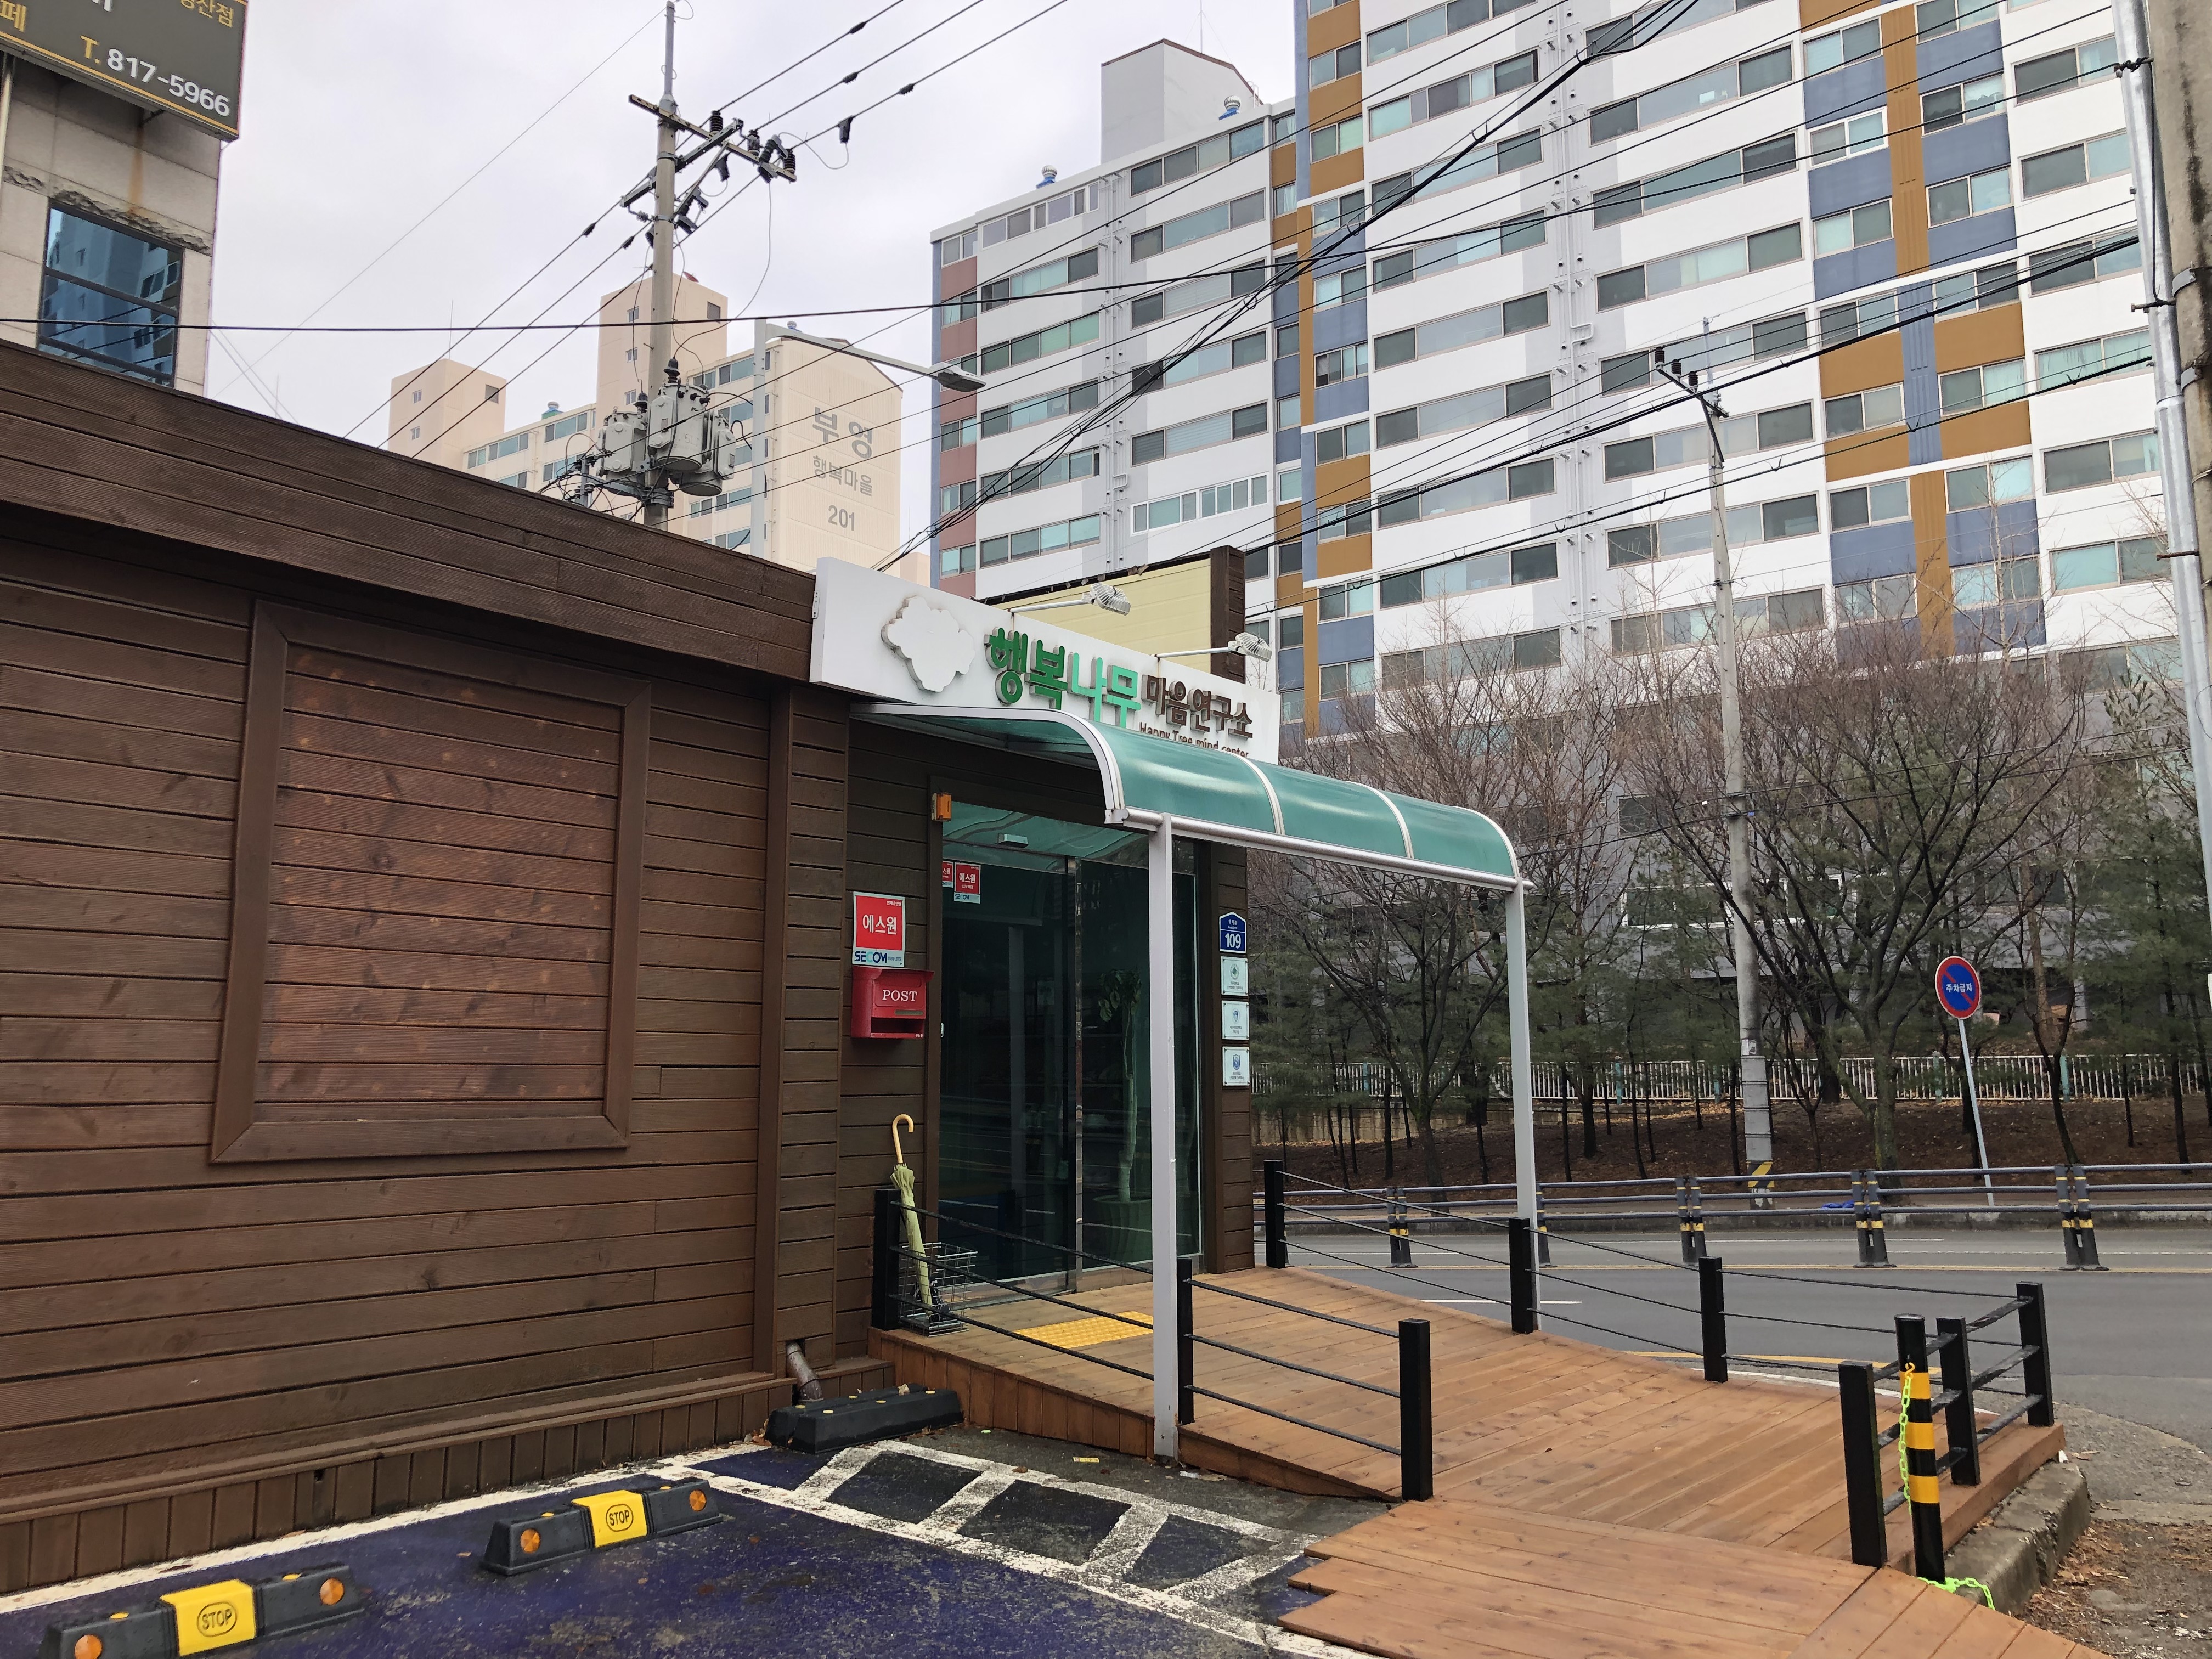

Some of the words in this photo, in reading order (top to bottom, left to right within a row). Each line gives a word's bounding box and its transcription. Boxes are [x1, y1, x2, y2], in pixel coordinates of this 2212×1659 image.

[107, 48, 230, 117] 817-5966
[813, 455, 873, 497] 행복마을
[828, 505, 855, 532] 201
[985, 627, 1141, 728] 행복나무
[1142, 675, 1253, 738] 마음연구소
[959, 872, 976, 884] 에스원
[862, 914, 897, 935] 에스원
[1224, 933, 1242, 949] 109
[854, 951, 888, 963] SECOM
[882, 989, 918, 1002] POST
[1946, 983, 1973, 992] 주차금지
[609, 1509, 630, 1526] STOP
[202, 1608, 232, 1630] STOP
